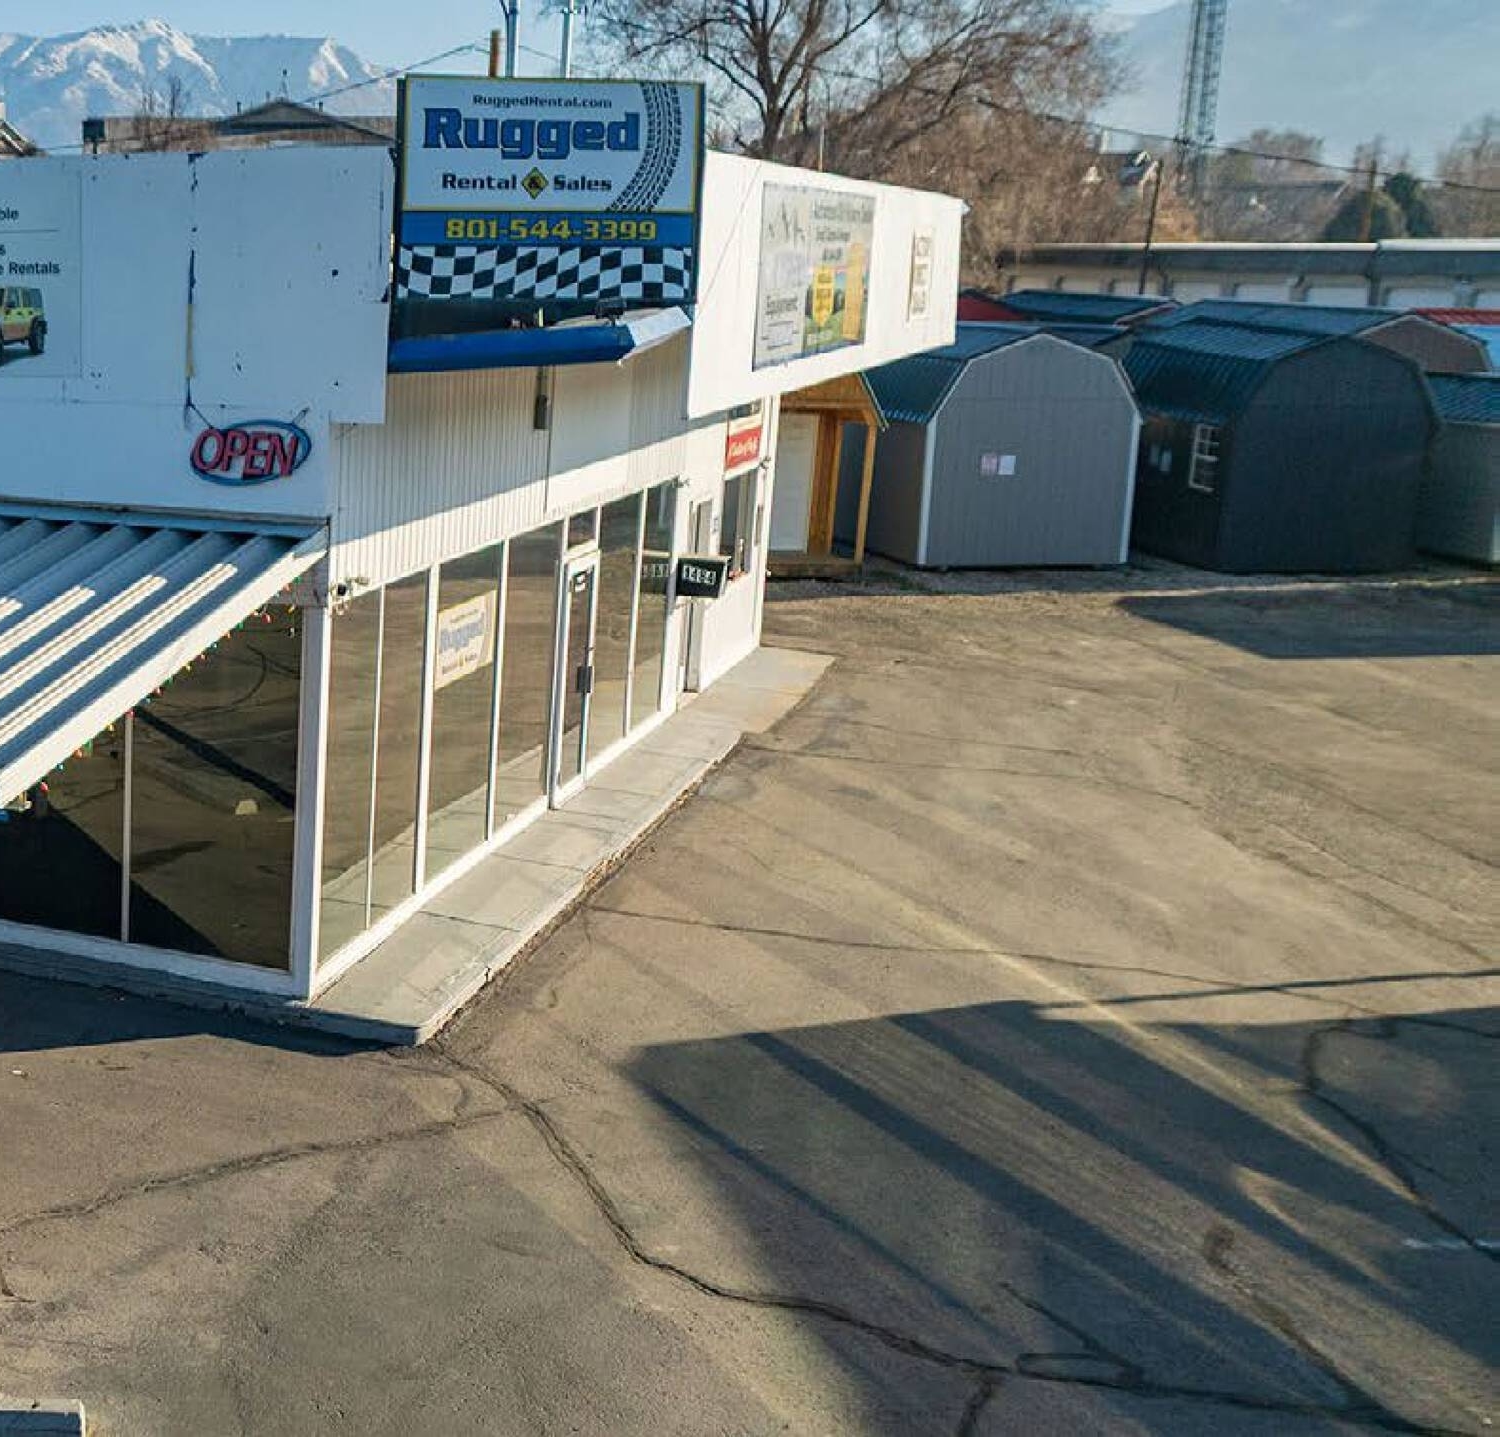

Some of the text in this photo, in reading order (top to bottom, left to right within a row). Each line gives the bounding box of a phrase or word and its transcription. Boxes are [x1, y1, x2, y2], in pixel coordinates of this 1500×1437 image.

[473, 94, 612, 109] RuggedRental.com
[423, 107, 640, 160] Rugged
[442, 173, 517, 191] Rental
[553, 175, 612, 192] Sales
[446, 218, 657, 241] 801-544-3399
[9, 261, 60, 275] Rentals
[192, 428, 299, 478] OPEN
